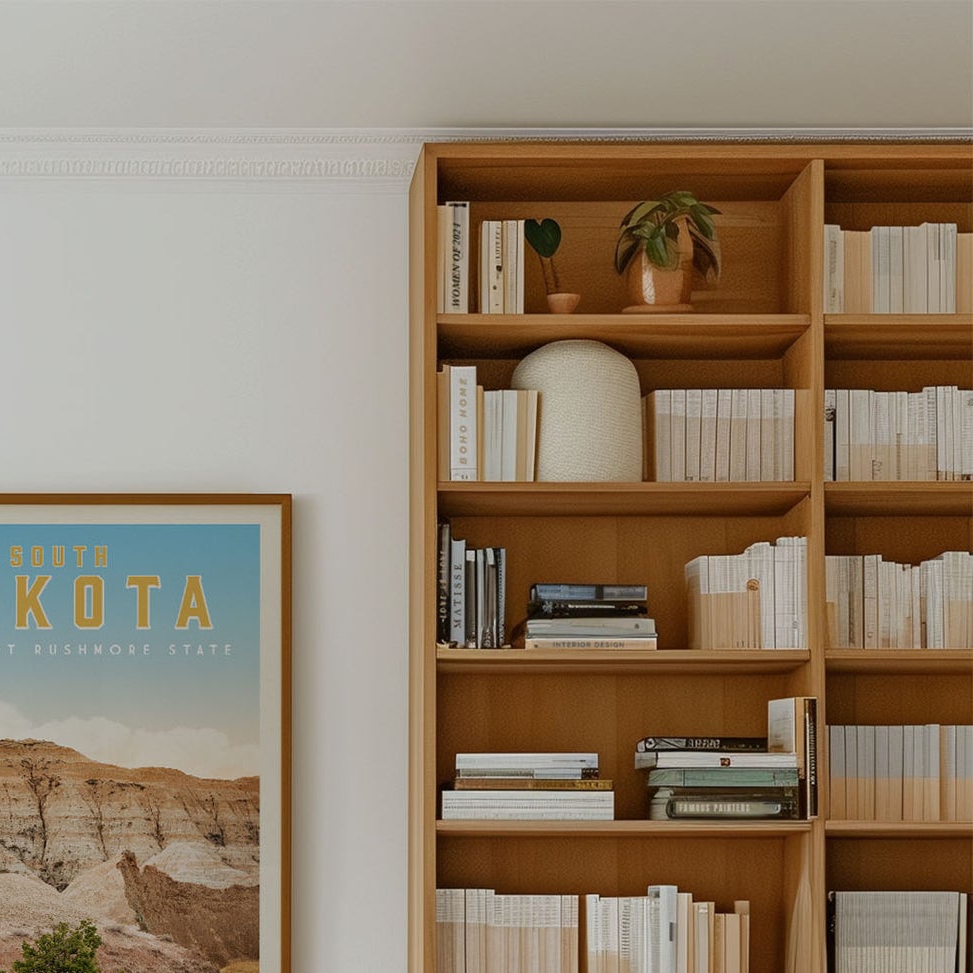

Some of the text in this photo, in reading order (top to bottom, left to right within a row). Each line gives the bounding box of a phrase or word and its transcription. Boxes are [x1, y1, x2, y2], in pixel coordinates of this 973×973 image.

[451, 247, 461, 262] OF
[451, 264, 461, 307] WOMEN
[458, 376, 468, 465] BOHO HOME
[9, 544, 109, 568] SOUTH
[453, 562, 462, 629] MATISSE
[35, 643, 151, 656] RUSHMORE
[168, 643, 234, 656] STATE
[678, 803, 750, 812] FAMOUS PAINTERS
